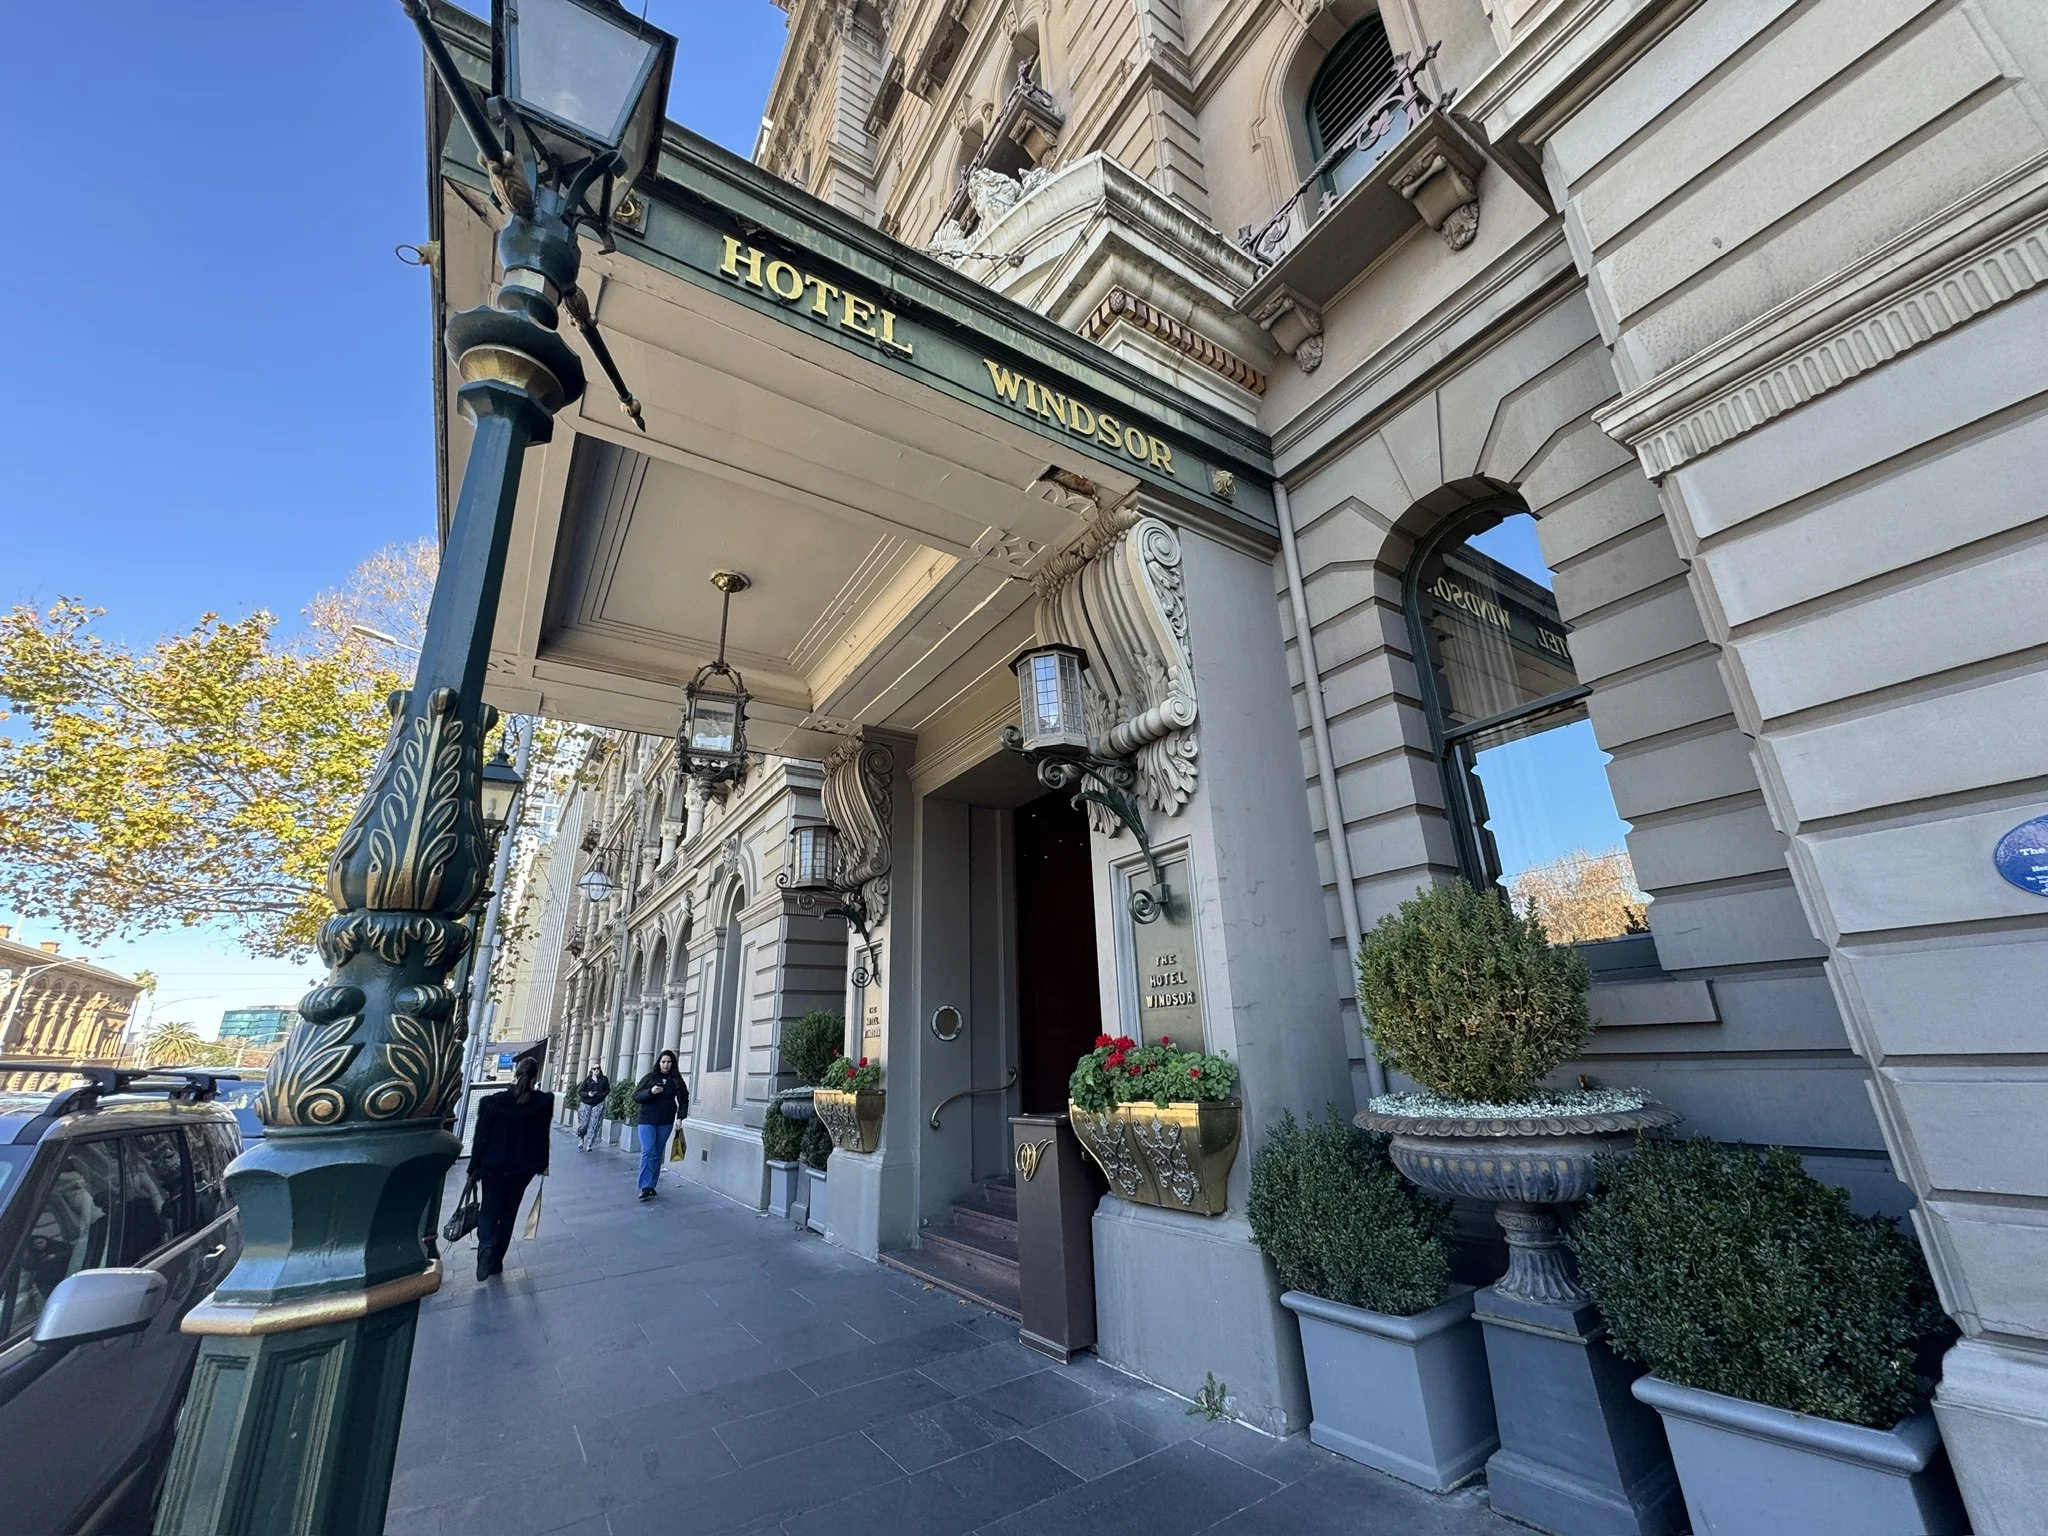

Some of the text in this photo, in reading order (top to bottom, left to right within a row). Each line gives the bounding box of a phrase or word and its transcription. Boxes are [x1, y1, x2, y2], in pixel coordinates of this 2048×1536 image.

[720, 234, 1175, 475] HOTEL WINDSOR
[1155, 954, 1177, 967] THE
[1149, 971, 1187, 988] HOTEL
[1145, 991, 1195, 1008] WINDSOR
